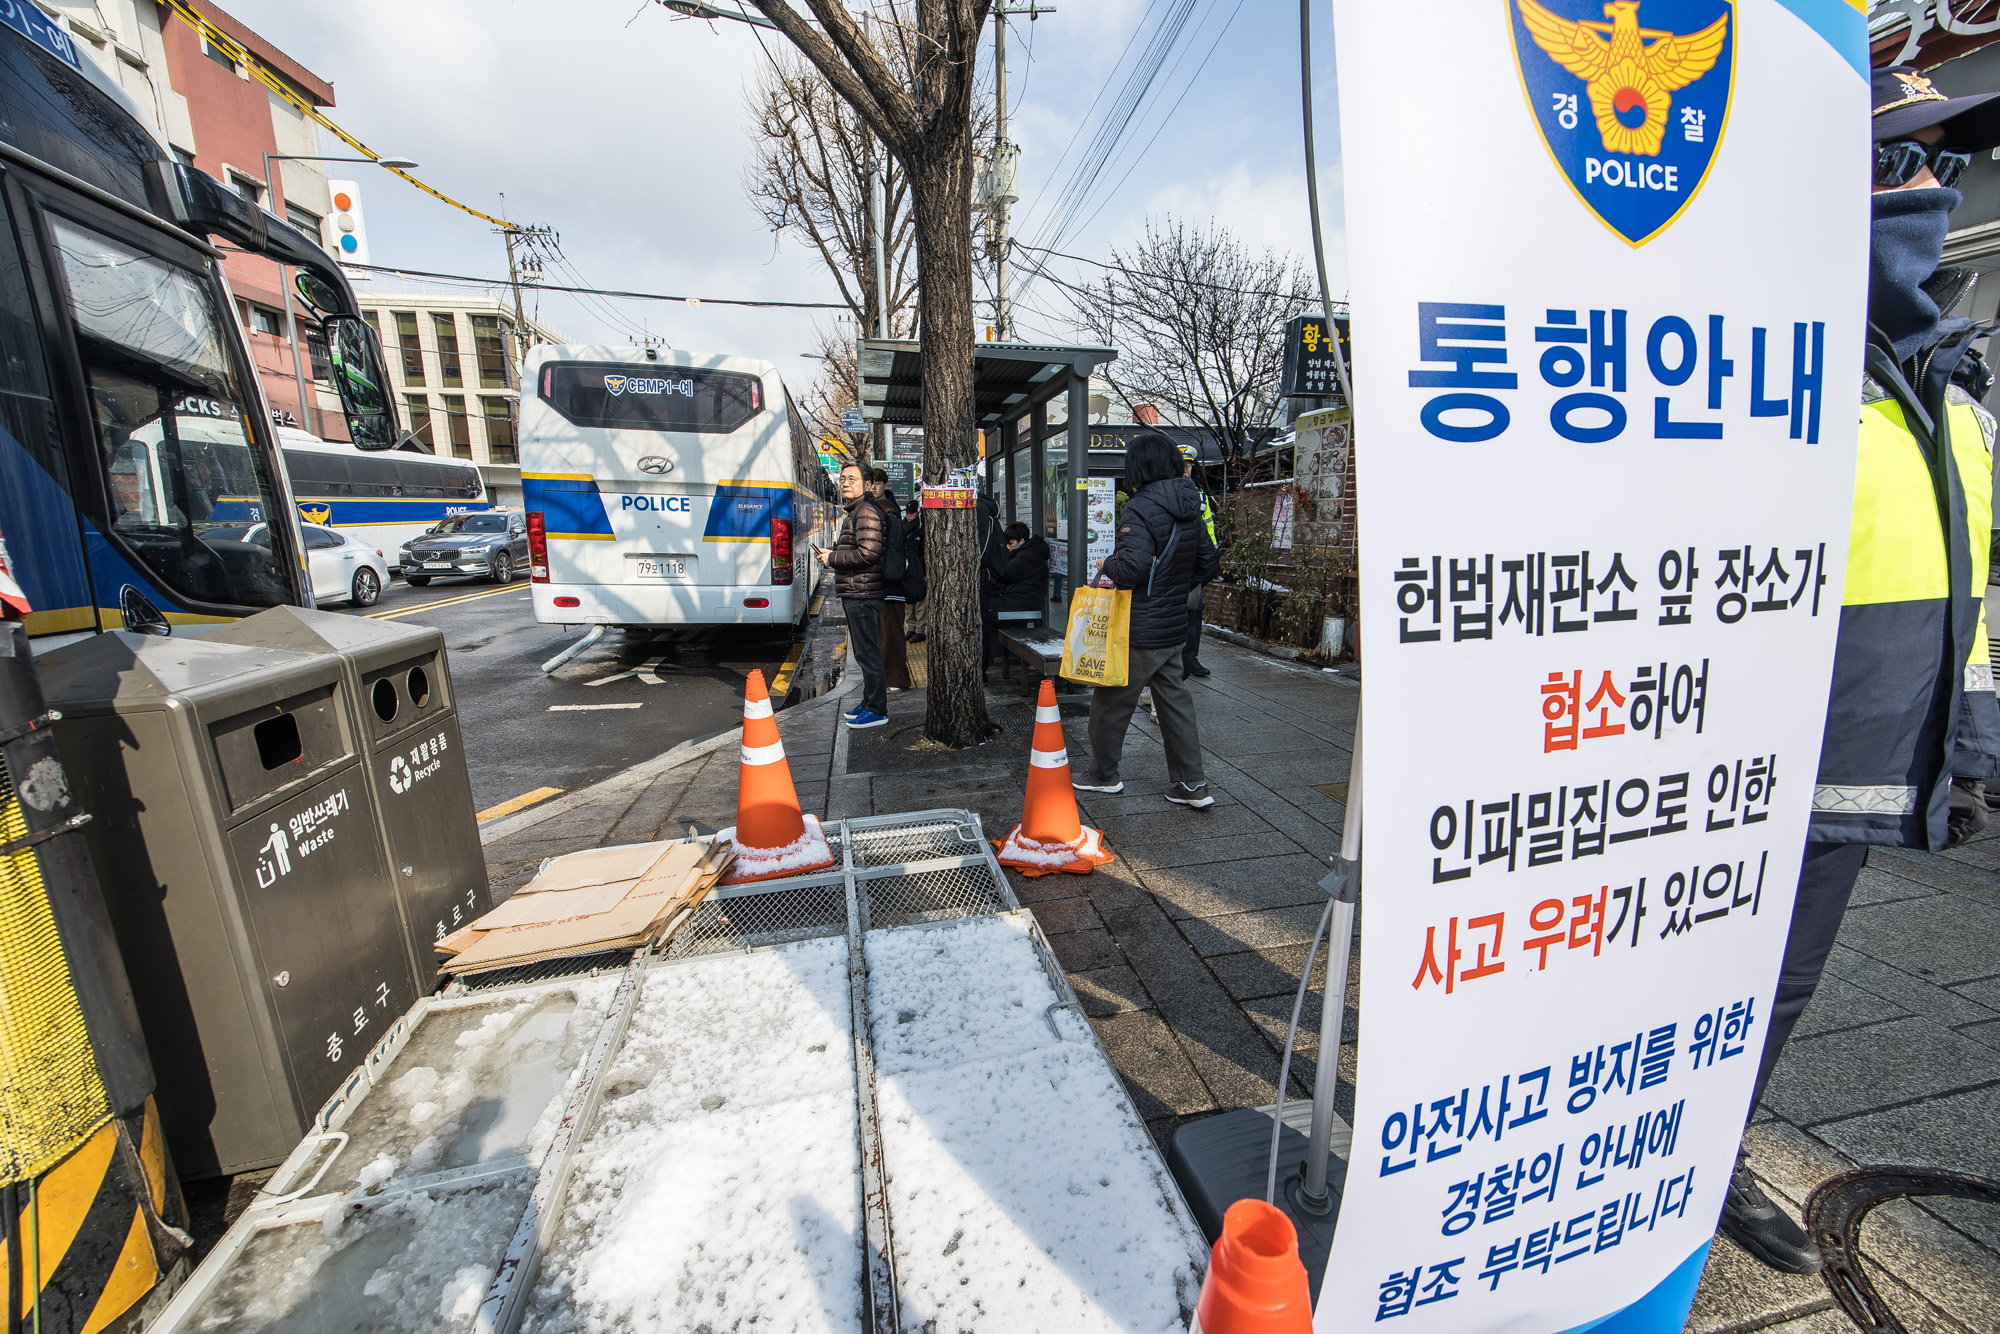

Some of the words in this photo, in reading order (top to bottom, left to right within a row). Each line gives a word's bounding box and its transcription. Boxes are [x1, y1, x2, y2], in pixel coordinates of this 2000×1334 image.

[1552, 93, 1578, 129] 경
[1681, 106, 1706, 142] 찰
[1585, 157, 1678, 192] POLICE
[626, 378, 693, 397] CBMP1-예
[1408, 301, 1825, 444] 통행안내
[230, 405, 299, 426] 스벅스
[1051, 434, 1127, 448] GDEN
[621, 496, 690, 512] POLICE
[638, 562, 685, 574] 79모1118
[1394, 551, 1638, 643] 헌법재판소
[1658, 547, 1699, 626] 앞
[1715, 542, 1826, 624] 장소가
[1541, 658, 1709, 753] 협소하여
[410, 732, 447, 765] 재활용품
[414, 758, 441, 782] Recycle
[289, 788, 349, 840] 일반쓰레기
[1430, 772, 1690, 884] 인파밀집으로
[1705, 754, 1776, 832] 인한
[298, 826, 335, 858] Waste
[1411, 912, 1505, 994] 사고
[1523, 877, 1646, 971] 우려가
[1660, 850, 1768, 940] 있으니
[1379, 1065, 1551, 1178] 안전사고
[1566, 1023, 1677, 1115] 방지를
[1689, 997, 1755, 1070] 위한
[1441, 1143, 1565, 1236] 경찰의
[1576, 1098, 1686, 1190] 안내에
[1375, 1256, 1466, 1322] 협조
[1478, 1166, 1696, 1291] 부탁드립니다
